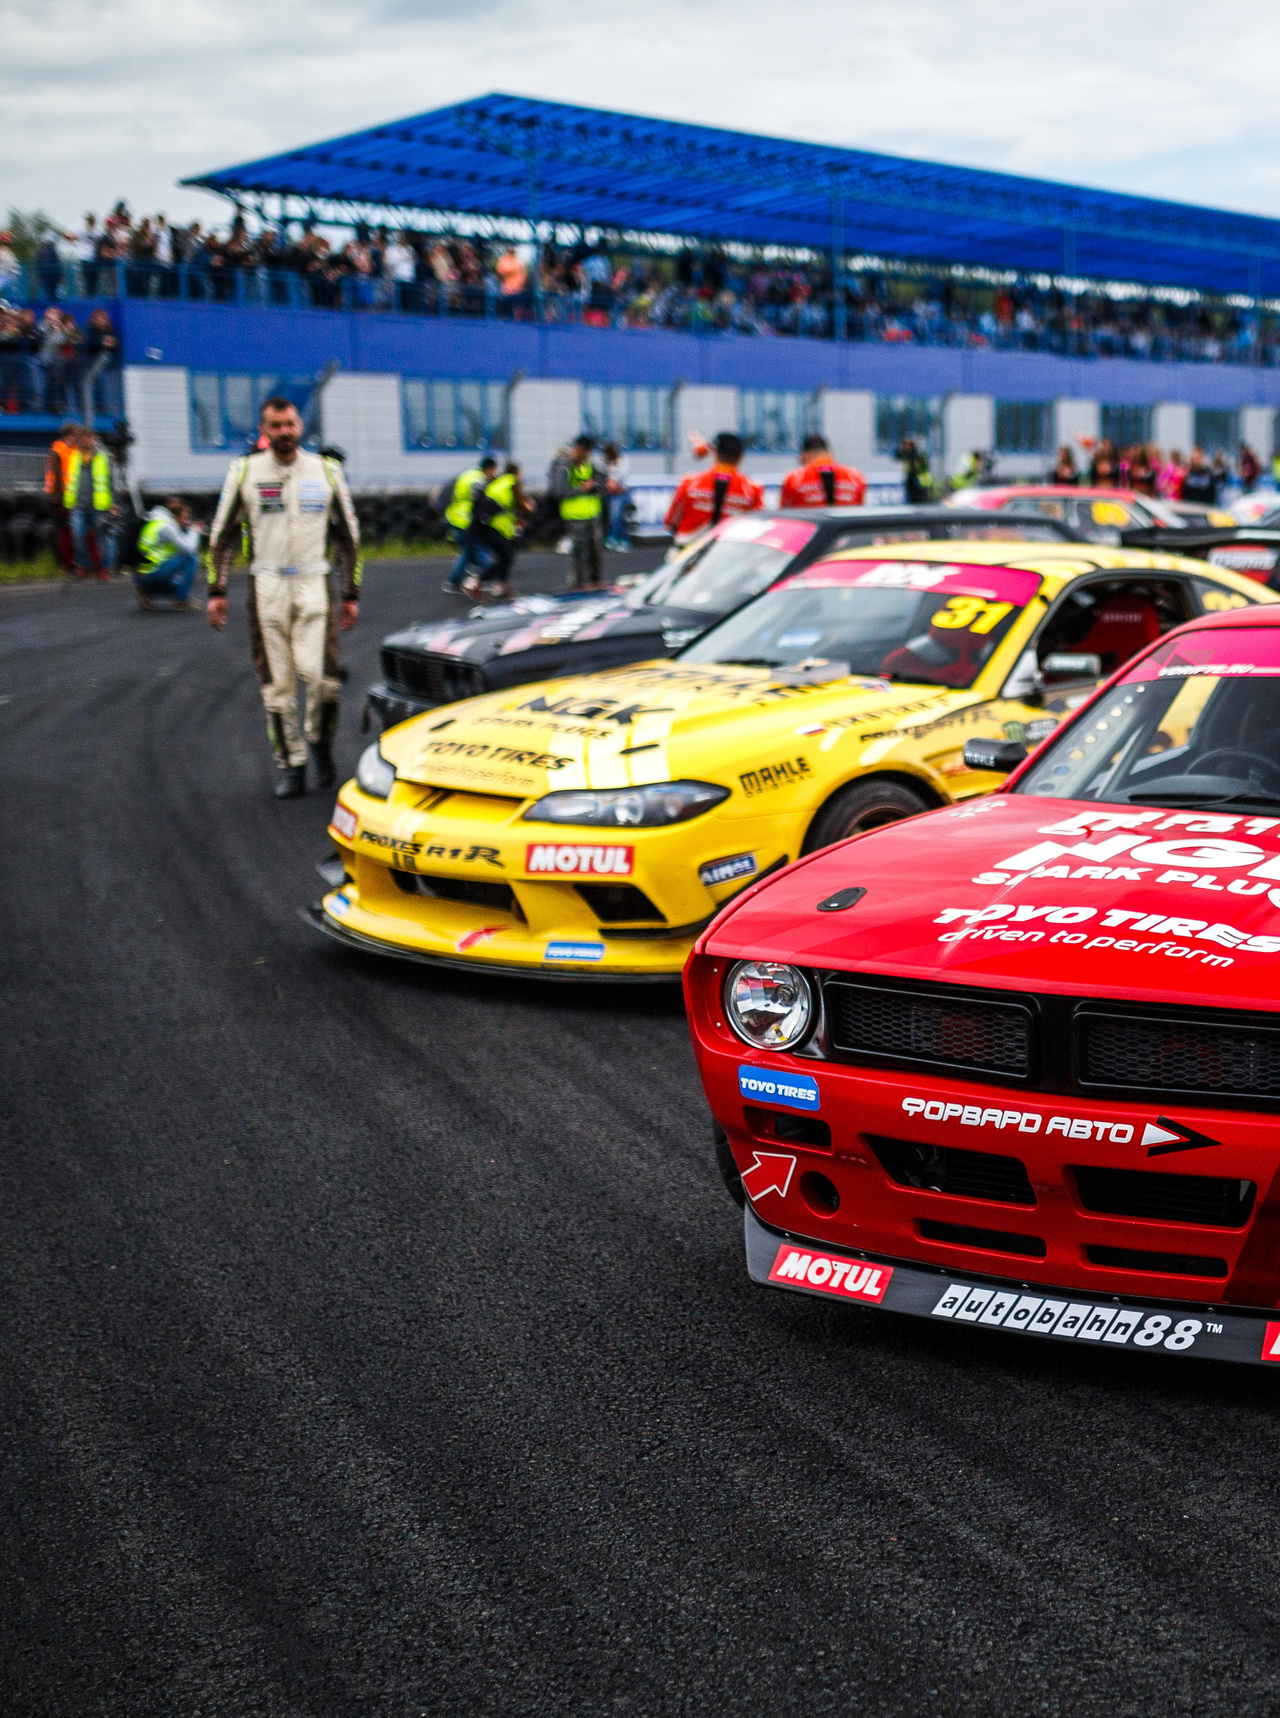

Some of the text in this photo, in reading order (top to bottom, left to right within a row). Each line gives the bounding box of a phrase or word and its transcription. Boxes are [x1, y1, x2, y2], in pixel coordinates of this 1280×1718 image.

[931, 596, 1014, 634] 31
[516, 695, 675, 725] NGK
[421, 741, 575, 771] TOYO TIRES
[739, 756, 811, 794] MAHLE
[359, 830, 505, 869] PROXES R1R
[529, 846, 630, 874] MOTUL
[971, 864, 1153, 886] SPARK
[932, 904, 1098, 924] TOYO
[937, 924, 1235, 968] driven to perform
[740, 1078, 816, 1101] TOYO TIRES
[901, 1097, 1134, 1144] ФОРВАРД АВТО
[776, 1252, 883, 1296] MOTUL
[933, 1285, 1203, 1350] autobahn88
